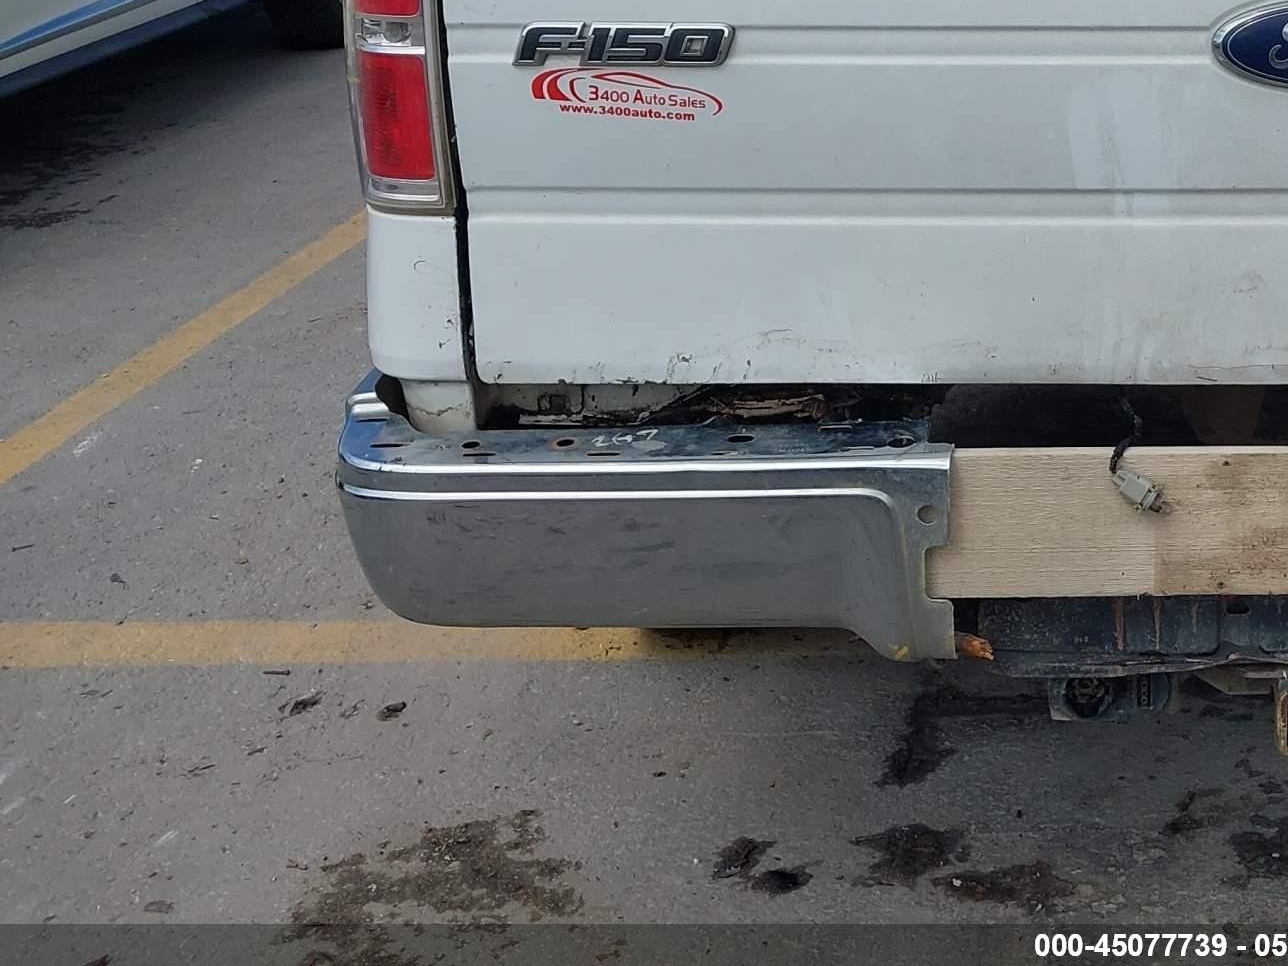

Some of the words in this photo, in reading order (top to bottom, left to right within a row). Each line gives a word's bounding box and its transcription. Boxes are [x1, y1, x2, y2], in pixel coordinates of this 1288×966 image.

[511, 20, 737, 68] F-150
[588, 85, 630, 103] 3400
[632, 89, 667, 106] Auto
[668, 94, 707, 109] Sales
[559, 103, 696, 122] www.3400auto.com
